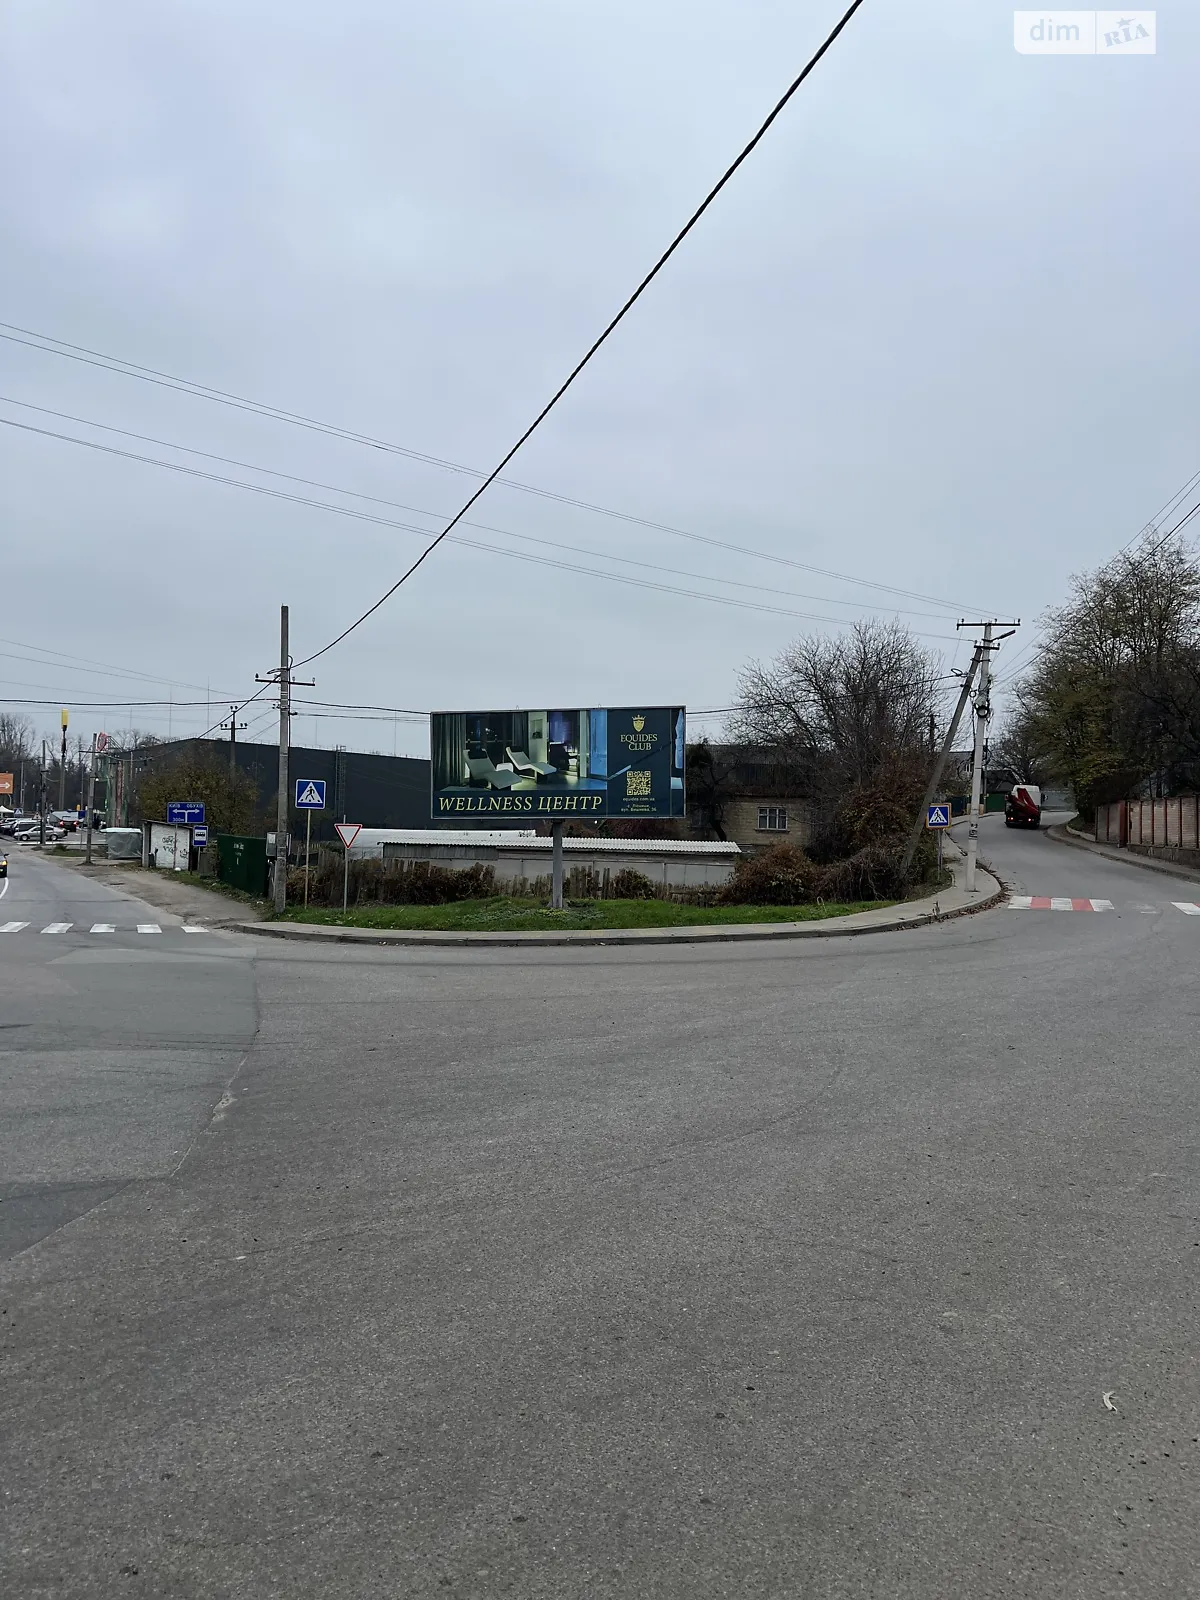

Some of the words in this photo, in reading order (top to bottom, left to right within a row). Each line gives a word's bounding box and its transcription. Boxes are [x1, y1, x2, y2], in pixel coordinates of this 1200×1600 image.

[620, 733, 658, 743] EQUIDES
[628, 742, 652, 751] CLUB
[438, 796, 533, 811] WELLNESS
[537, 795, 603, 813] ЦЕНТР
